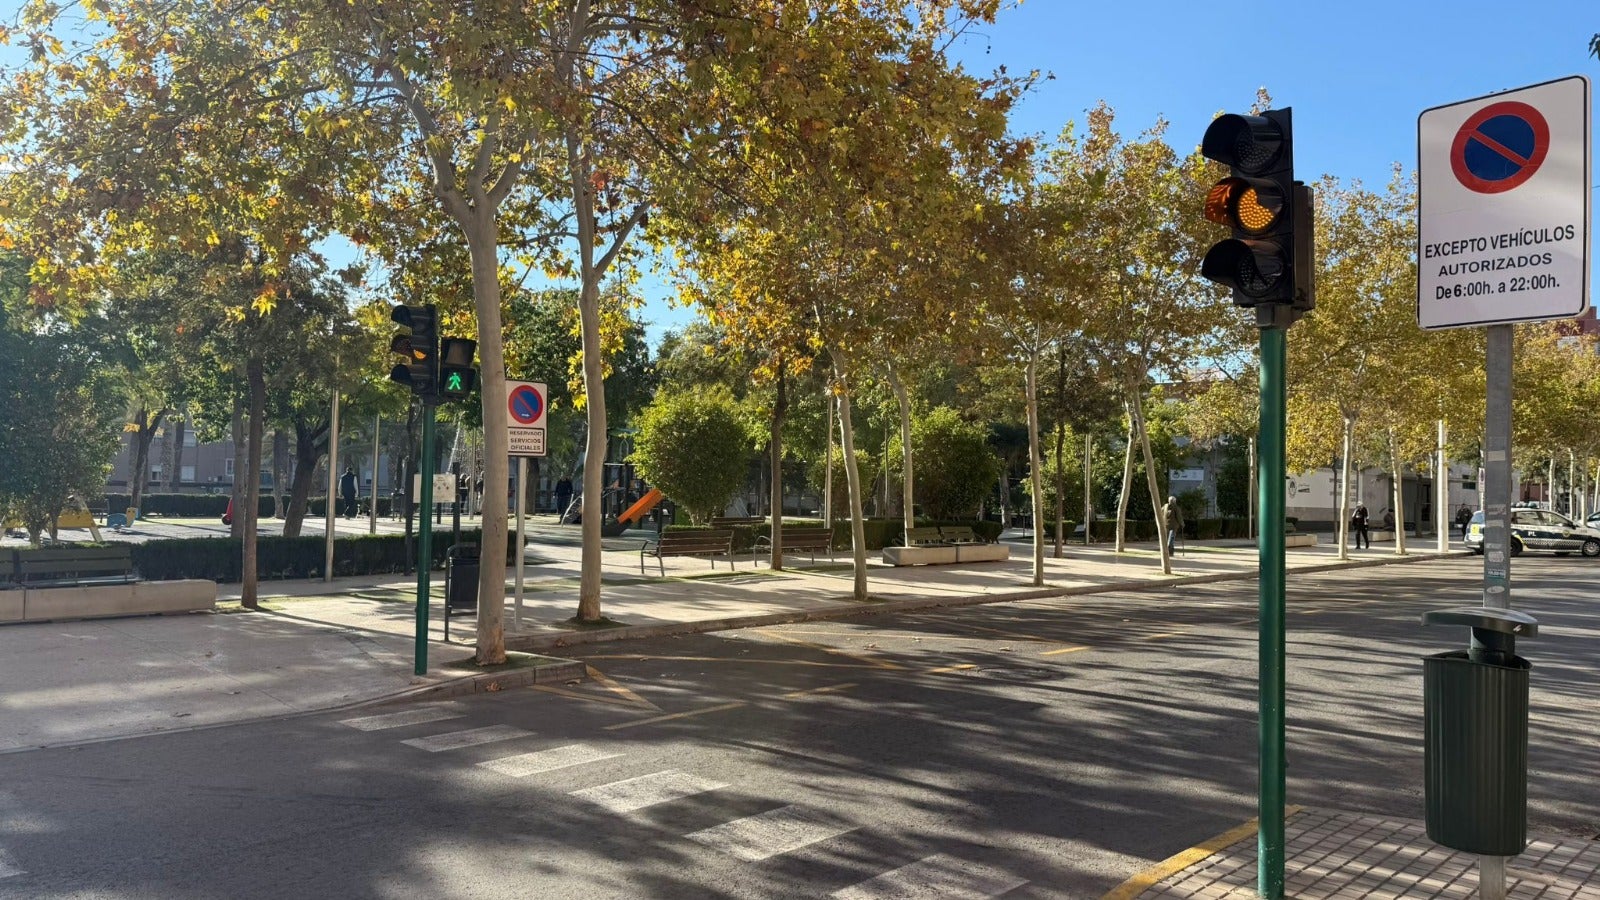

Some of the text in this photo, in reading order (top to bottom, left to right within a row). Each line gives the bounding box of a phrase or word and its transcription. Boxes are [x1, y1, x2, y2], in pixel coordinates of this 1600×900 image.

[1425, 224, 1575, 258] EXCEPTO VEHÍCULOS
[1438, 253, 1552, 277] AUTORIZADOS
[1498, 282, 1506, 293] a
[1510, 274, 1560, 292] 22:00h.
